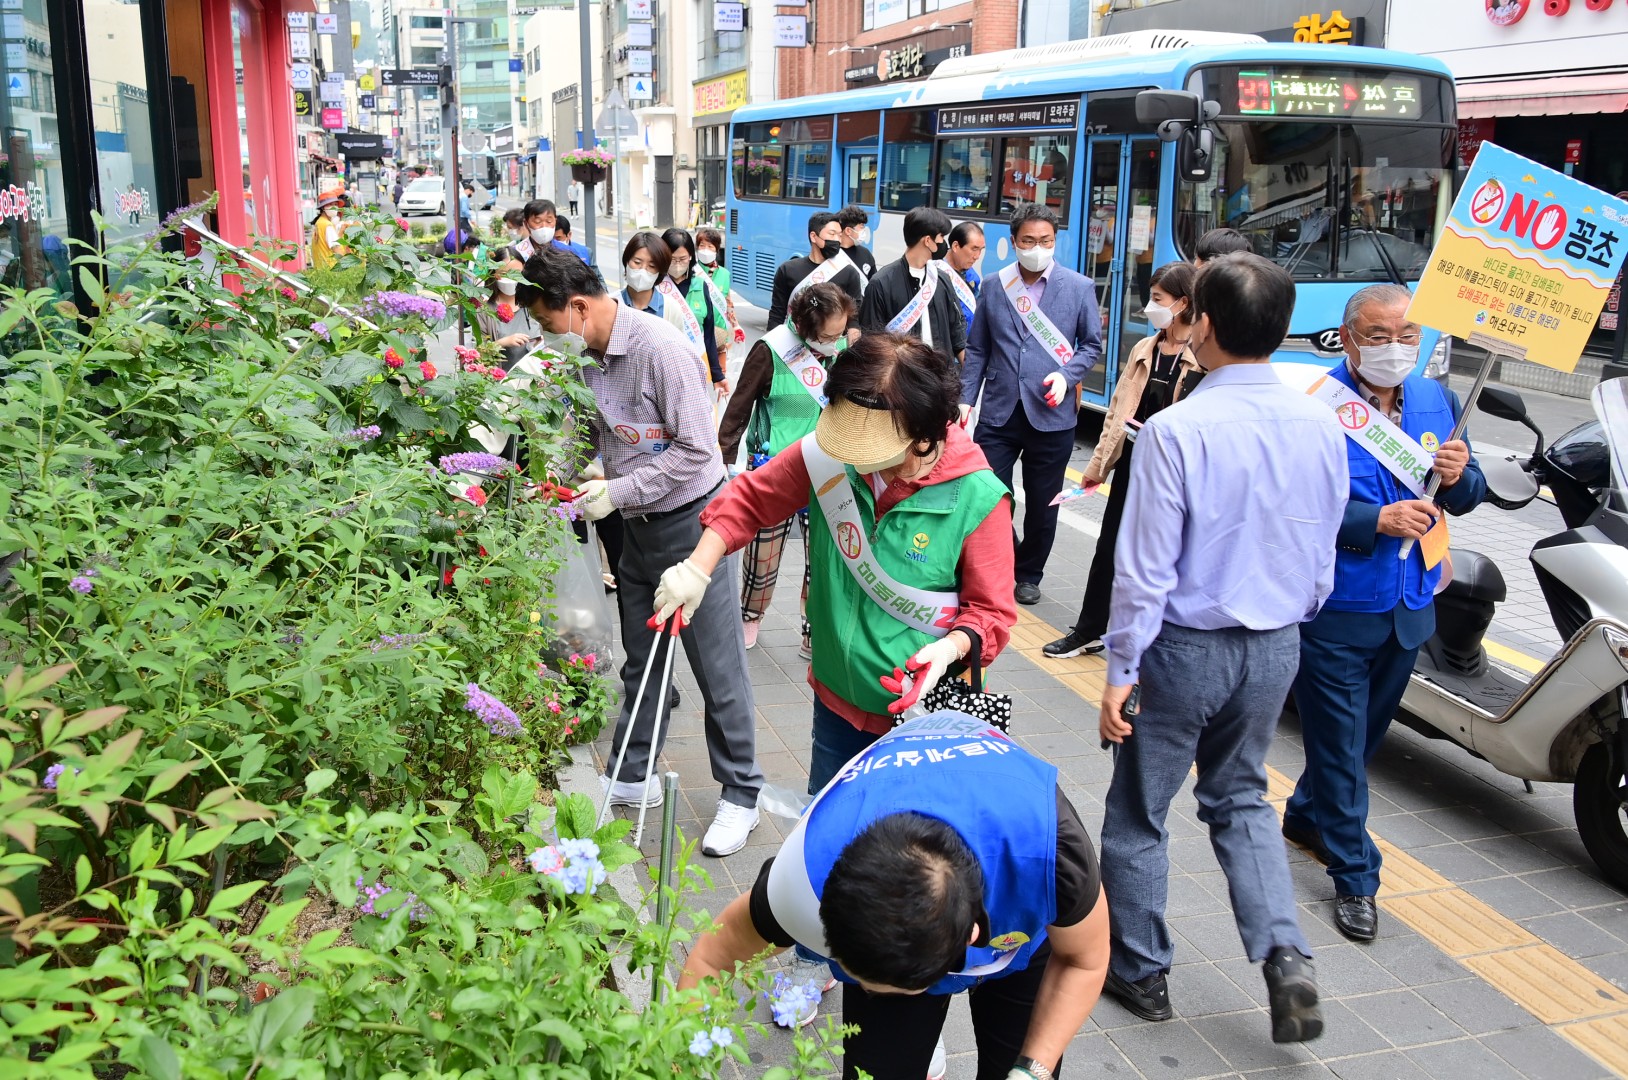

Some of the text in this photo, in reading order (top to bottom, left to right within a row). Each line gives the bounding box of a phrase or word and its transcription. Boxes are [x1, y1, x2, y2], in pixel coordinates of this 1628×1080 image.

[888, 42, 925, 78] 호천당
[963, 114, 976, 124] 안락동
[980, 113, 994, 124] 동래역
[998, 112, 1014, 122] 부전시장
[1019, 111, 1041, 121] 서부터미널
[1050, 105, 1075, 117] 모라주공
[1500, 192, 1620, 268] NO 꽁초
[1483, 257, 1508, 274] 바다로
[1507, 266, 1532, 284] 흘러간
[1436, 259, 1593, 324] 해양 미세플라스틱이 되어 물고기 먹이가 됩니다
[1457, 285, 1560, 331] 담배꽁초 없는 아름다운 해운대
[1489, 315, 1527, 338] 해운대구
[1365, 424, 1427, 485] 담배꽁초
[904, 549, 928, 563] SMU
[856, 560, 938, 624] 담배꽁초
